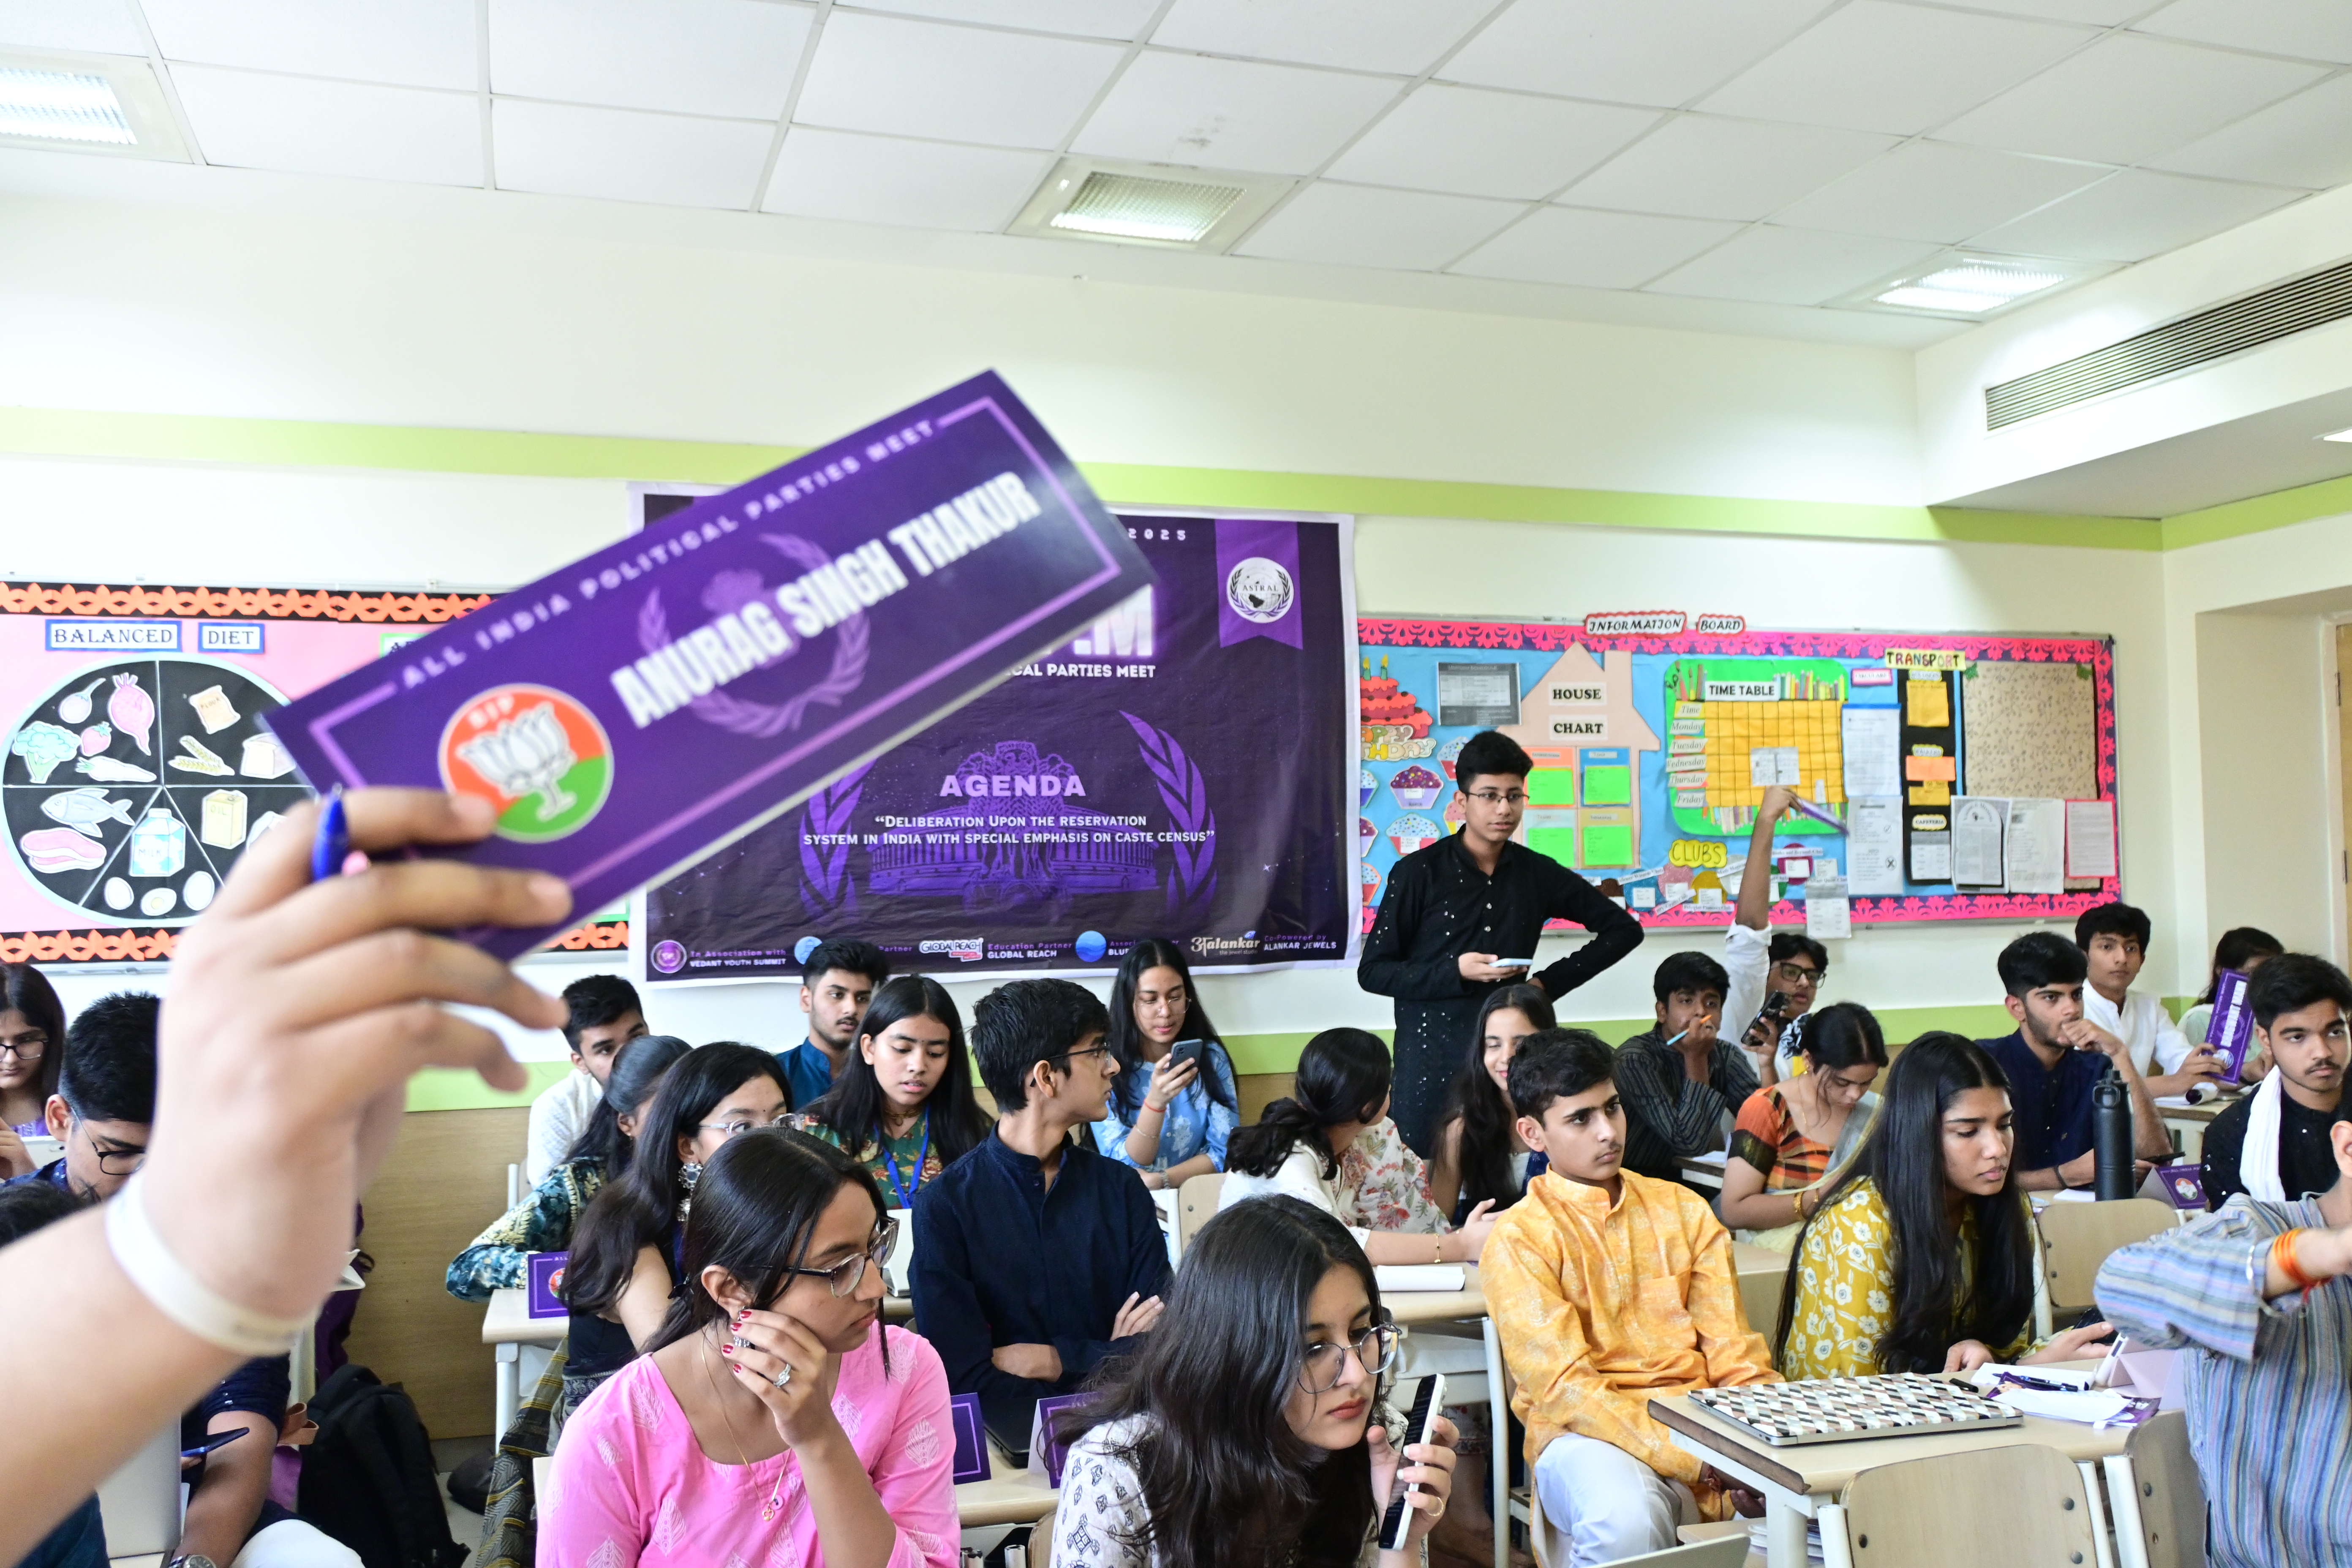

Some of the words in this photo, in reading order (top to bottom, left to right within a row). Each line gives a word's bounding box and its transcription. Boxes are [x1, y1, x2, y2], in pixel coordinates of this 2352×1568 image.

[1127, 528, 1186, 541] 2025
[402, 645, 466, 689] ALL
[475, 594, 571, 651] INDIA
[579, 515, 738, 599] POLITICAL
[744, 455, 860, 520] PARTIES
[866, 419, 933, 463] MEET
[1242, 584, 1279, 592] ASTRAL
[609, 601, 793, 730] ANURAG
[776, 538, 908, 639] SINGH
[887, 470, 1042, 580] THAKUR
[1589, 618, 1682, 632] INFORMATION
[1700, 620, 1741, 631] BOARD
[54, 629, 172, 643] BALANCED
[208, 631, 254, 645] DIET
[1886, 651, 1960, 667] TRANSPORT
[1047, 664, 1112, 677] PARTIES
[1116, 665, 1156, 678] MEET
[1552, 689, 1601, 700] HOUSE
[1709, 685, 1736, 696] TIME
[1739, 685, 1775, 696] TABLE
[200, 697, 222, 710] FLOUR
[1682, 705, 1700, 714] Time
[1553, 723, 1603, 734] CHART
[1671, 722, 1703, 733] Monday
[1361, 727, 1413, 743] APPY
[1671, 741, 1704, 751] Tuesday
[1670, 775, 1705, 786] Thursday
[939, 775, 1086, 798] AGENDA
[1677, 795, 1704, 806] Friday
[210, 805, 227, 816] OIL
[989, 815, 1026, 828] UPON
[1031, 816, 1055, 827] THE
[1060, 815, 1147, 827] RESERVATION
[804, 834, 859, 846] SYSTEM
[863, 834, 878, 845] IN
[883, 833, 922, 844] INDIA
[926, 833, 960, 844] WITH
[964, 833, 1019, 844] SPECIAL
[1024, 832, 1089, 844] EMPHASIS
[1094, 832, 1111, 843] ON
[1115, 831, 1153, 843] CASTE
[139, 848, 161, 857] MILK
[1672, 842, 1722, 865] CLUBS
[921, 942, 954, 952] GLOBAL
[955, 942, 980, 952] REACH
[1263, 942, 1300, 951] ALANKAR
[1303, 942, 1337, 950] JEWELS
[987, 950, 1024, 959] GLOBAL
[1026, 950, 1057, 958] REACH
